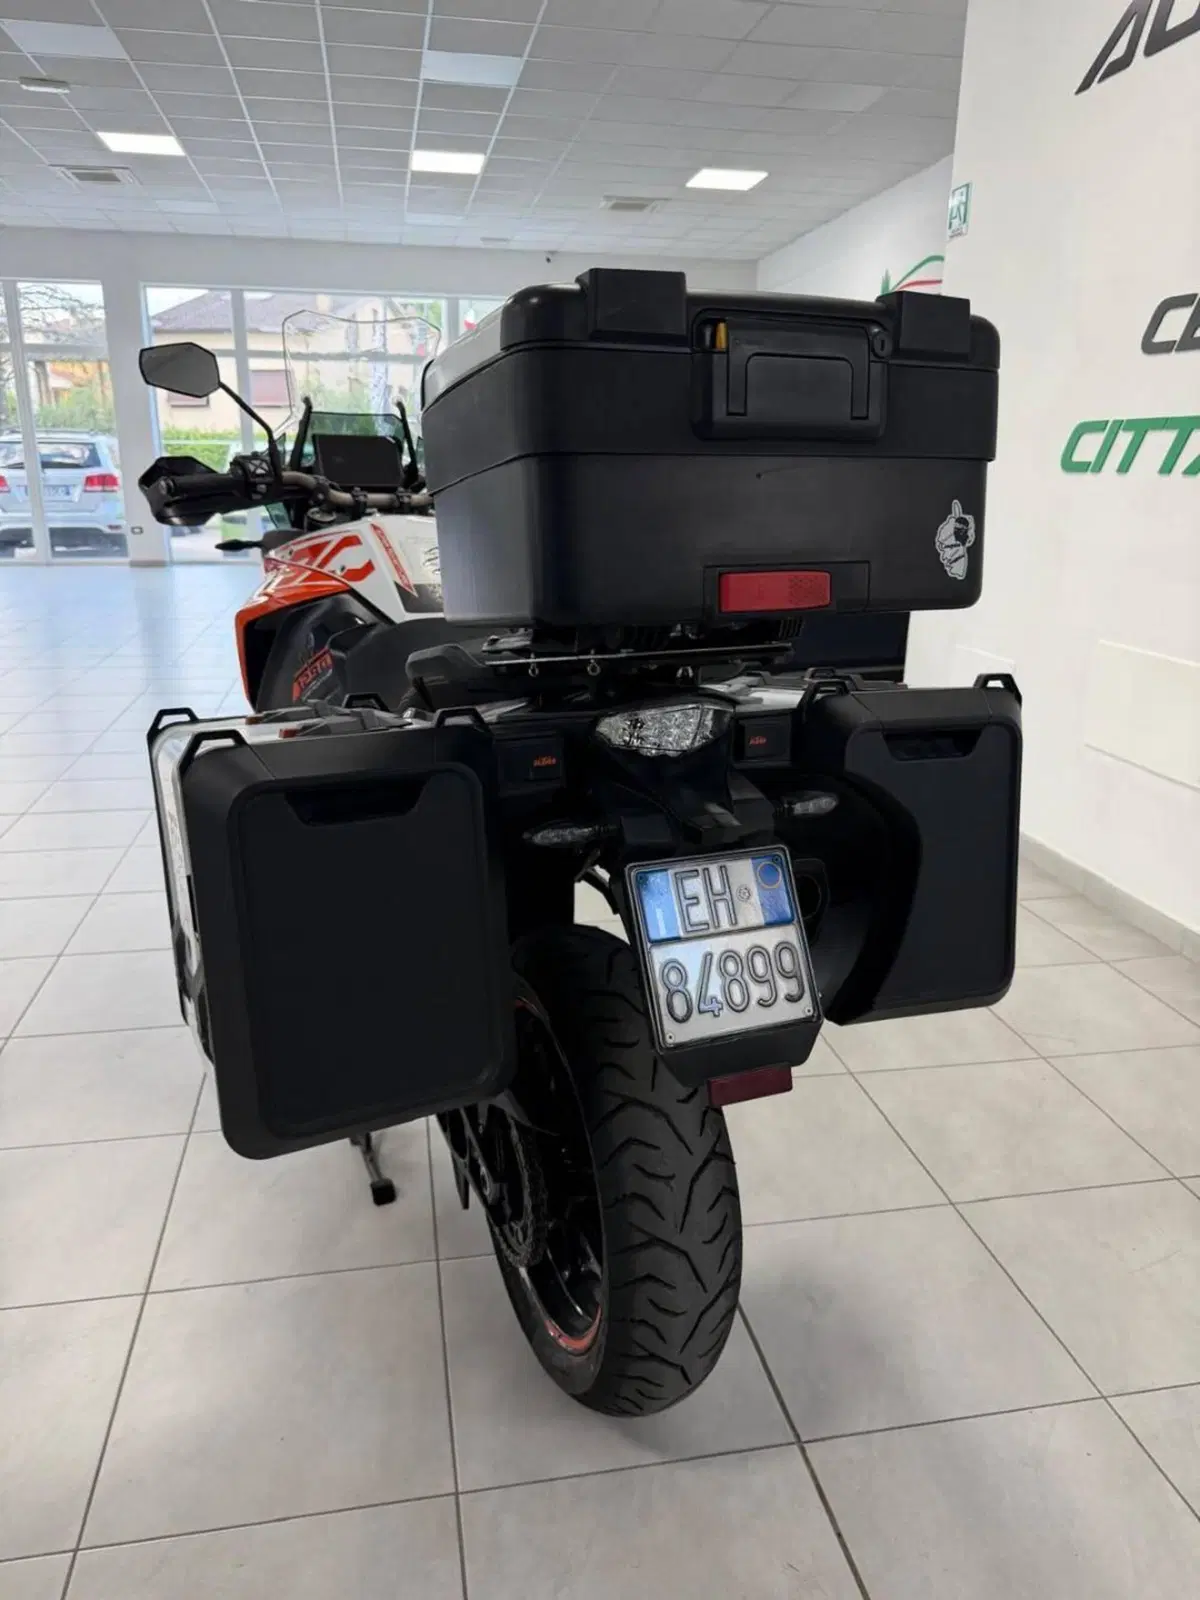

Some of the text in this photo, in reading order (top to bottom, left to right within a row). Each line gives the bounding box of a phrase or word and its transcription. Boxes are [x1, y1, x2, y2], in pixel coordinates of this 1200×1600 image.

[1060, 415, 1200, 476] CITT
[673, 865, 737, 933] EH
[660, 941, 805, 1023] 84899
